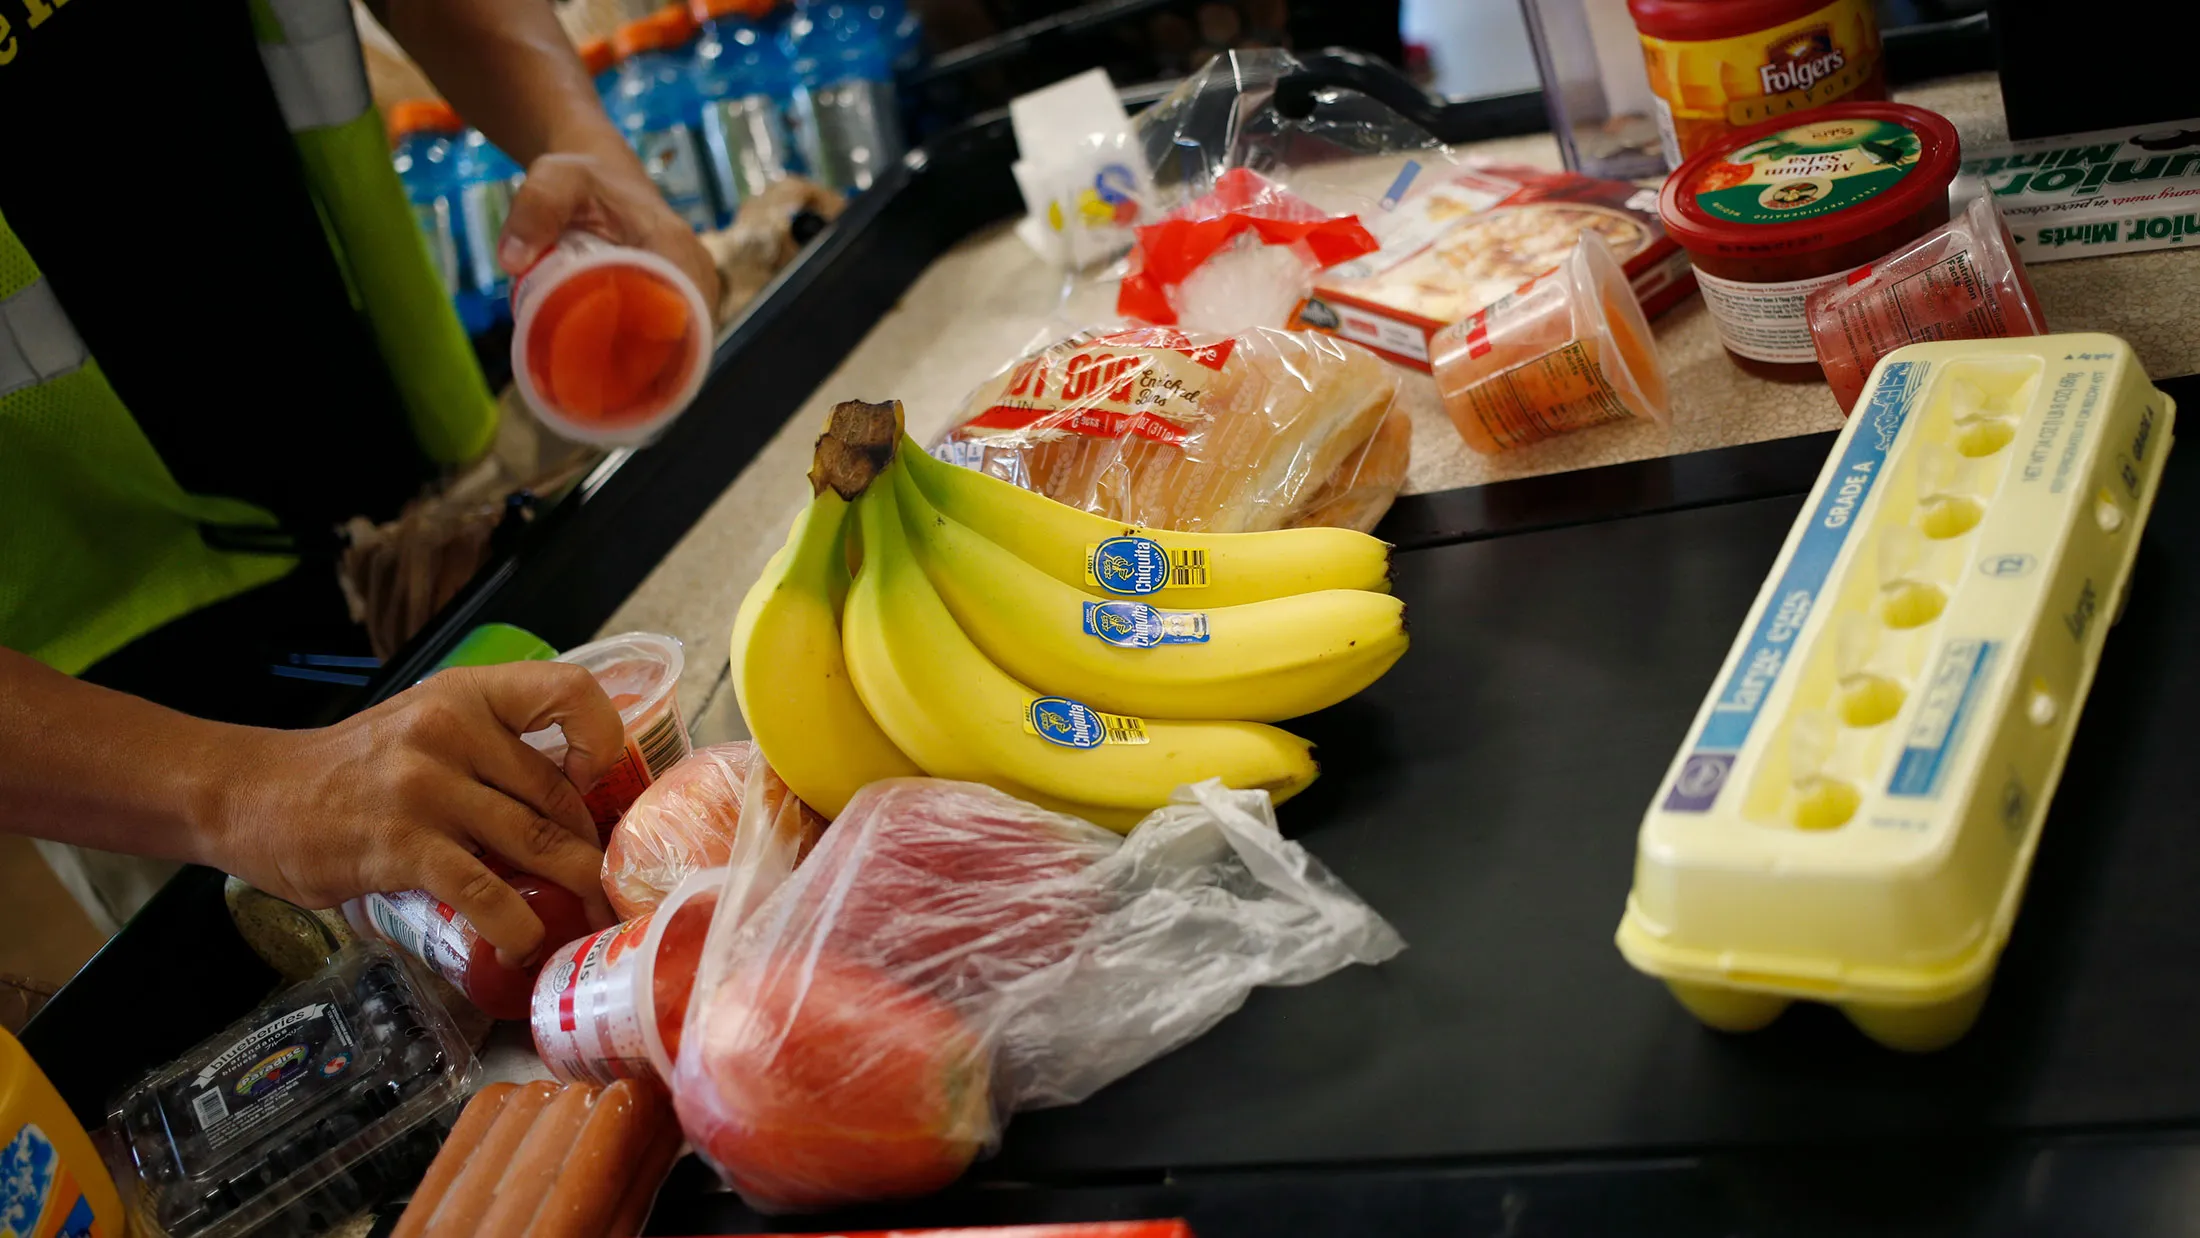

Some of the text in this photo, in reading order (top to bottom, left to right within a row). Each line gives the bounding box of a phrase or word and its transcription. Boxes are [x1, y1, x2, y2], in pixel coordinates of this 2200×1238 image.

[1760, 50, 1845, 94] Folgers
[1764, 161, 1856, 176] Medium
[1788, 153, 1844, 165] Salsa
[2052, 199, 2104, 213] pure
[2093, 199, 2109, 209] in
[2112, 194, 2157, 207] mints
[2037, 221, 2119, 247] Mints
[1946, 259, 1962, 287] Facts
[1956, 255, 1978, 300] Nutrition
[1562, 349, 1579, 377] Facts
[1571, 346, 1595, 387] Nutrition
[1824, 459, 1875, 529] GRADE A
[1087, 554, 1095, 575] #4011
[1135, 541, 1152, 594] Chiquita
[1153, 551, 1164, 584] Guatemala
[1995, 557, 2025, 576] 12
[1131, 604, 1149, 648] Chiquita
[1715, 588, 1812, 713] large eggs
[1073, 703, 1090, 748] Chiquita
[210, 1009, 306, 1071] blueberries
[222, 1053, 258, 1077] bleuets
[240, 1046, 302, 1086] Paradise
